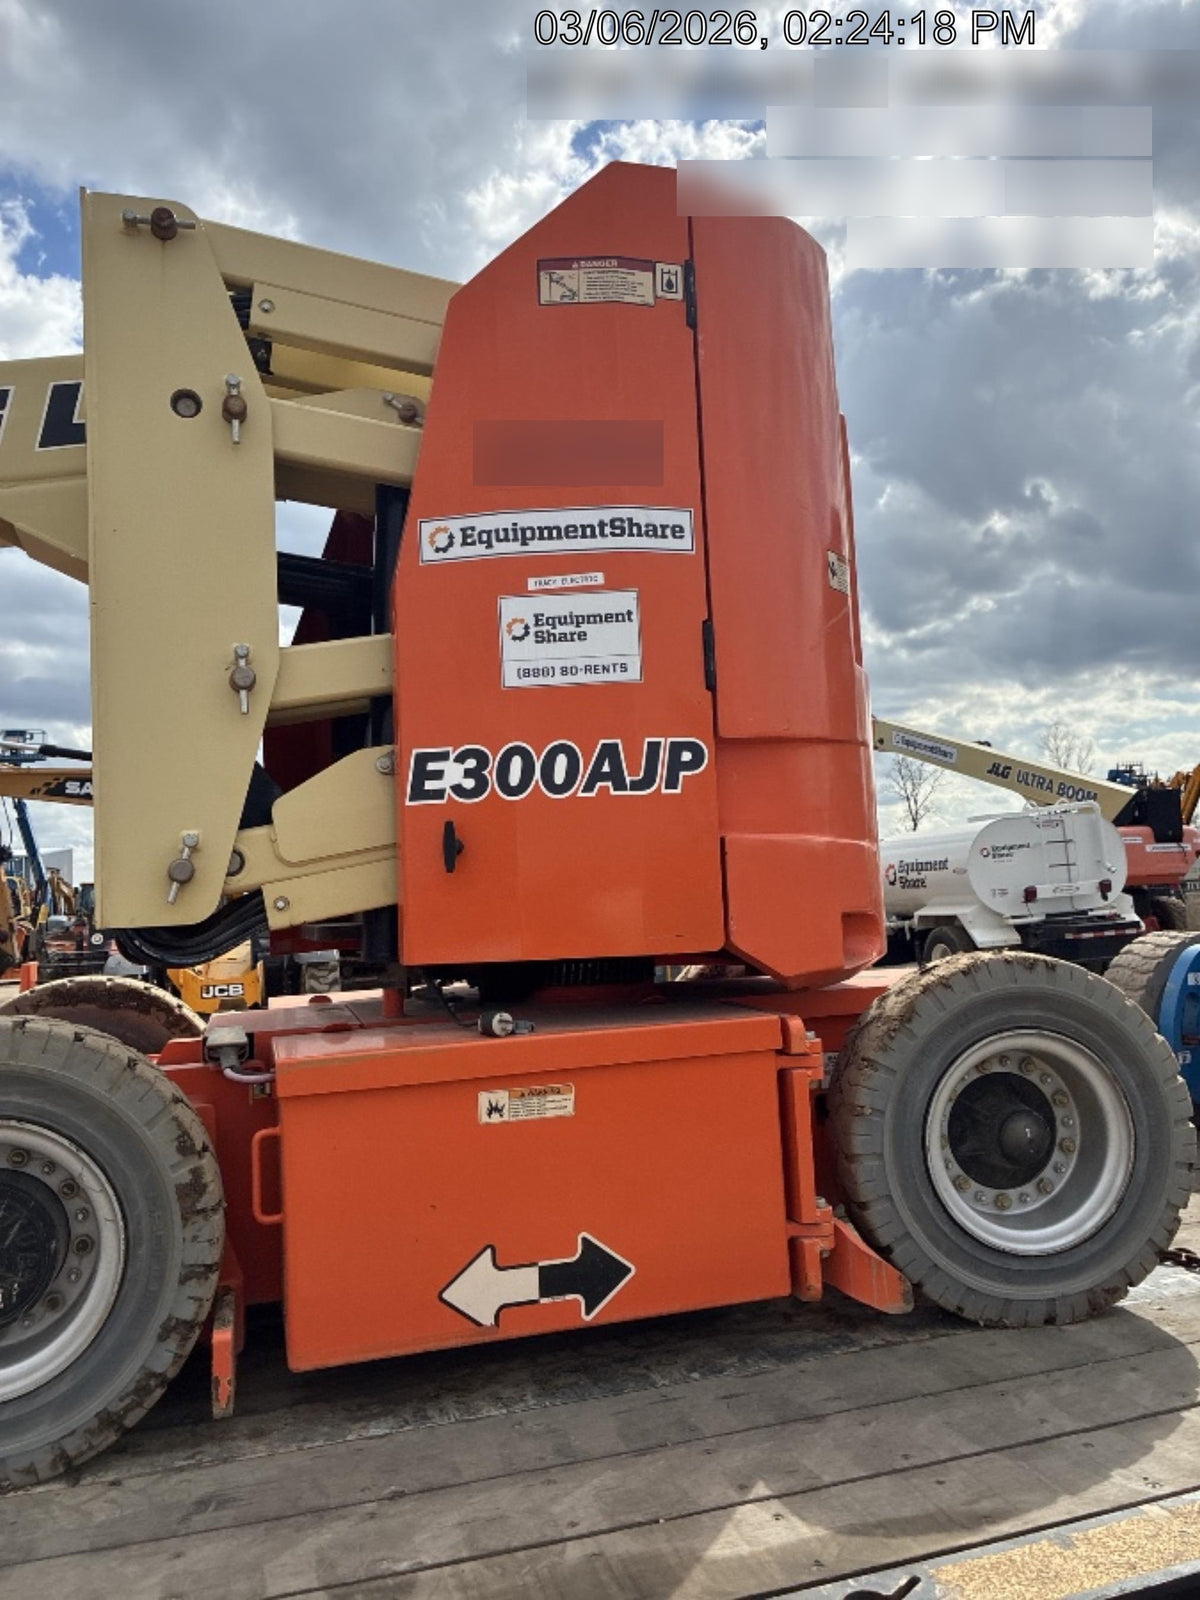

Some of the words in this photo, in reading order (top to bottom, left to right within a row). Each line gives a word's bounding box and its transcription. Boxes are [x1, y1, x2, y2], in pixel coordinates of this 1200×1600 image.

[580, 258, 618, 268] DANGER
[460, 517, 685, 549] EquipmentShare
[533, 609, 634, 630] Equipment
[534, 629, 588, 644] Share
[517, 665, 556, 679] (888)
[560, 662, 628, 676] 80-RENTS
[406, 739, 707, 806] E300AJP
[986, 761, 1012, 779] JLG
[1016, 769, 1054, 793] ULTRA
[898, 857, 949, 875] Equipment
[201, 984, 244, 998] JCB
